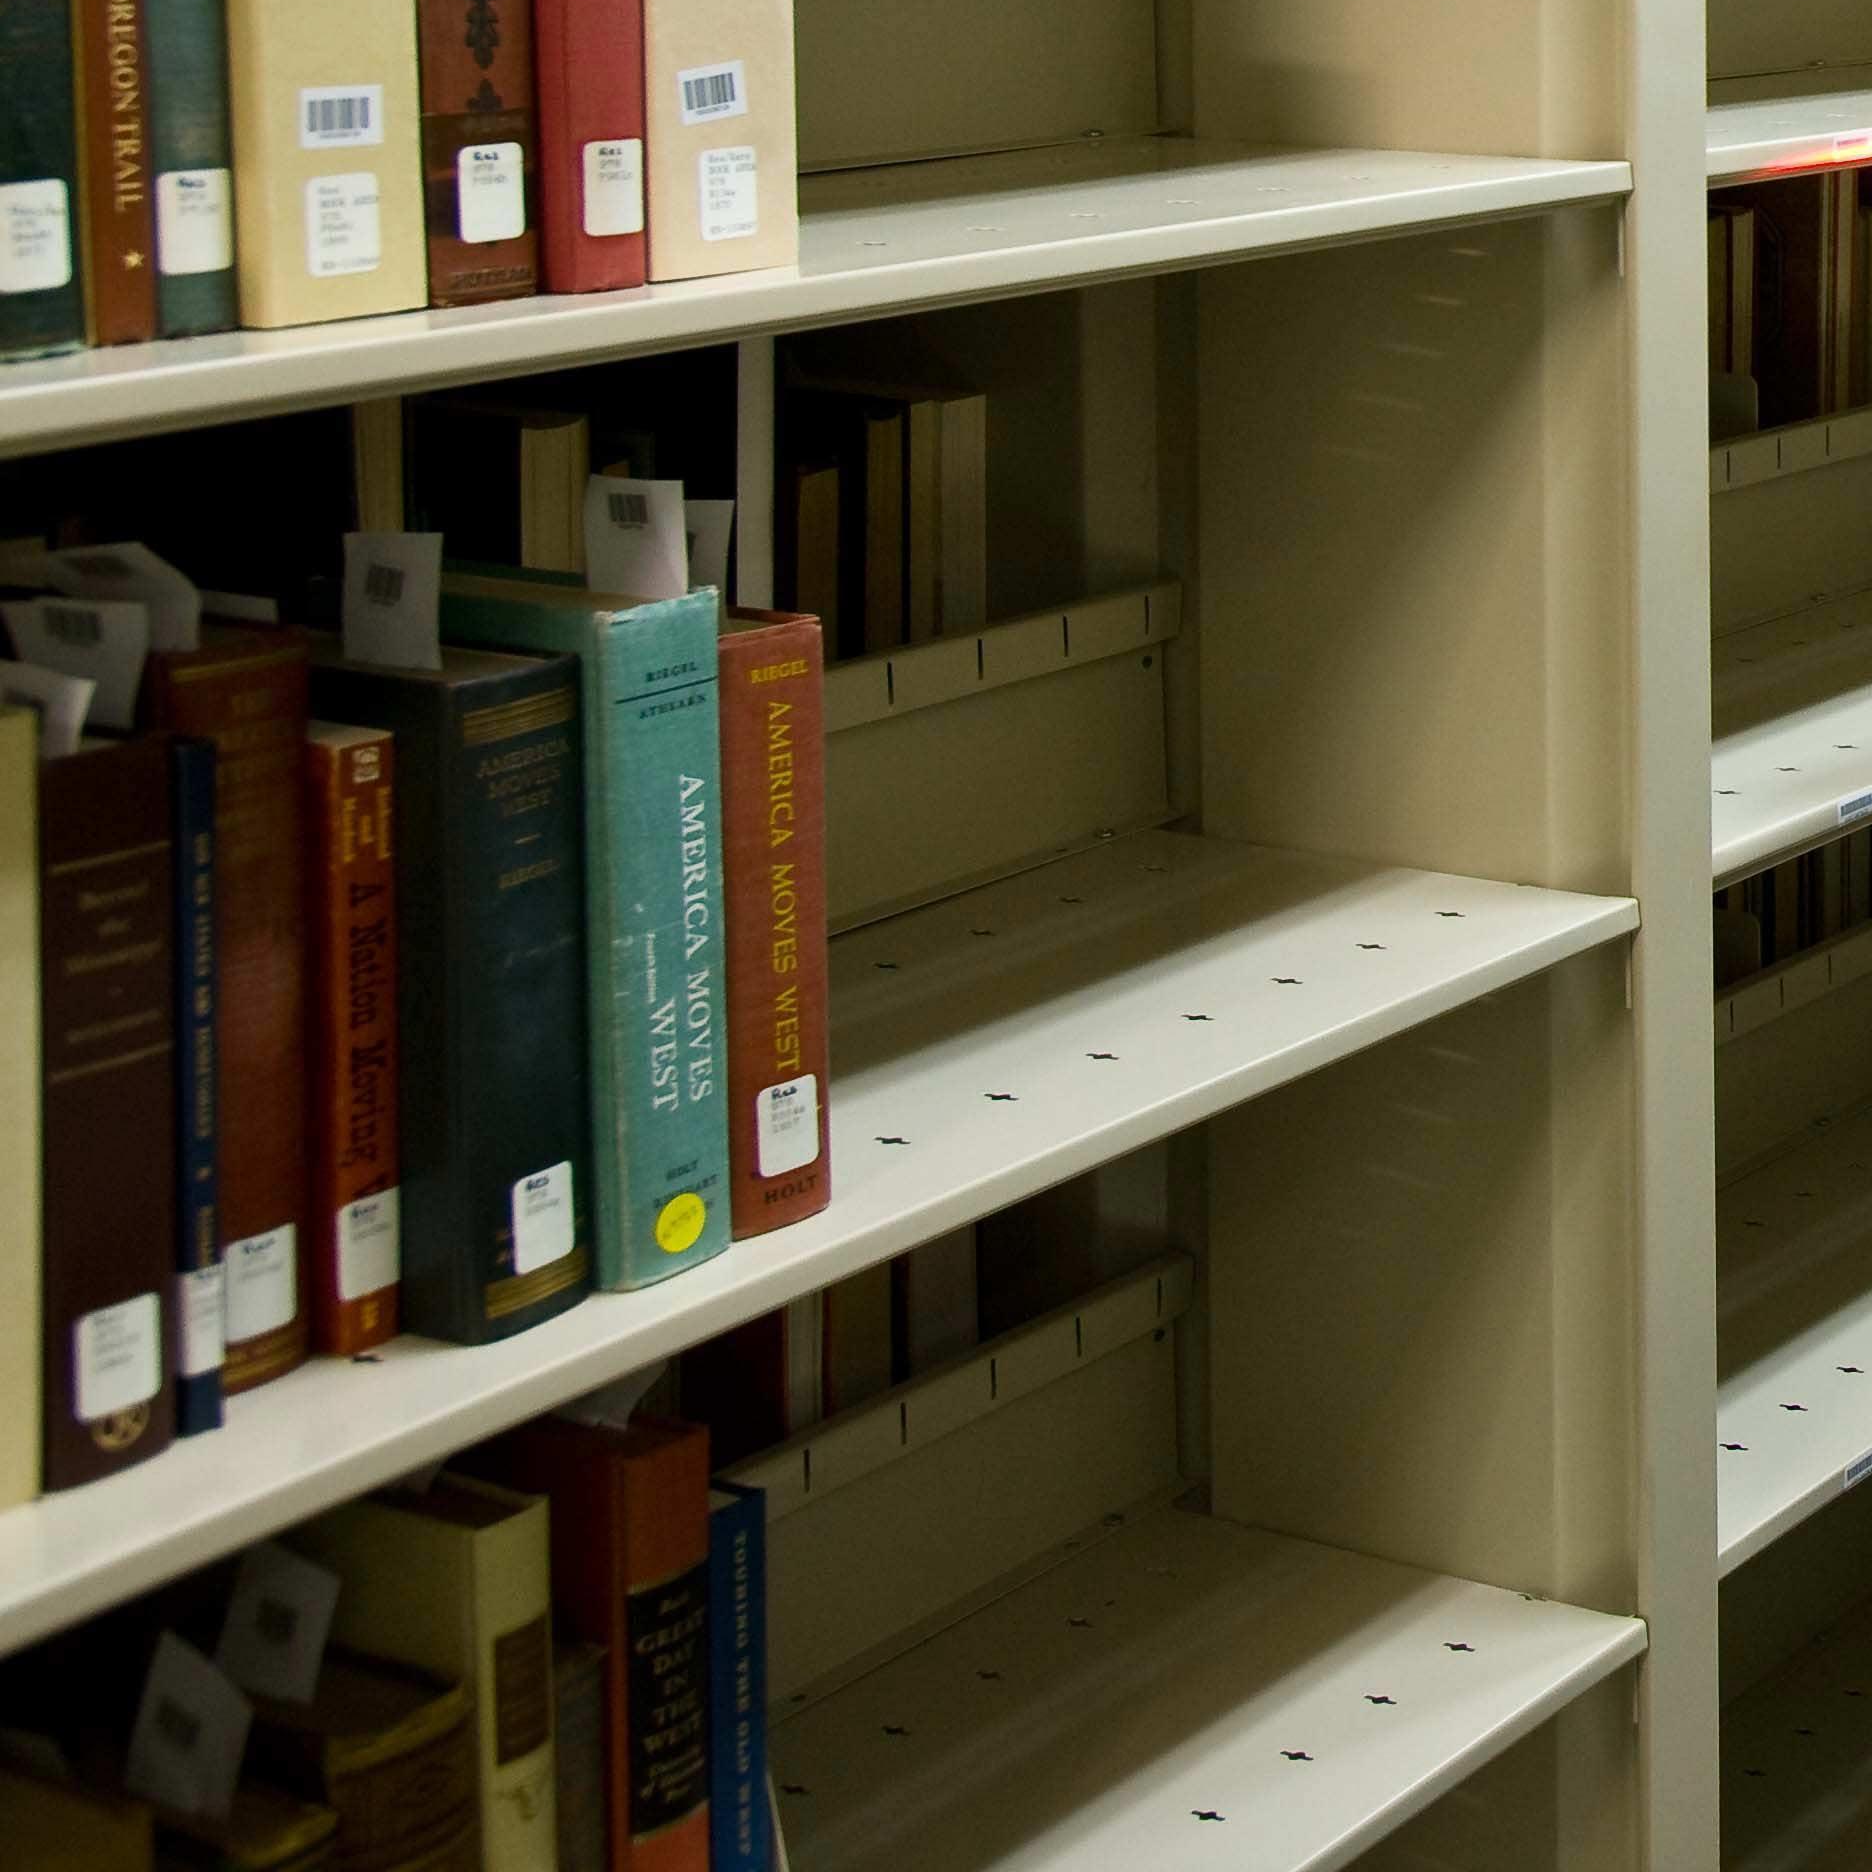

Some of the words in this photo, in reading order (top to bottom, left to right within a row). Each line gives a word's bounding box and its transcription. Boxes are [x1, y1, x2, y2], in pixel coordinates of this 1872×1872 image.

[112, 121, 144, 213] TRAIL
[644, 661, 699, 684] RIEGEL
[749, 659, 809, 685] RIEGEL
[475, 736, 571, 780] AMERICA
[767, 700, 796, 849] AMERICA
[349, 882, 384, 907] A
[679, 773, 710, 961] AMERICA
[770, 863, 798, 975] MOVES
[348, 919, 385, 1029] Nation
[650, 996, 680, 1113] WEST
[688, 969, 714, 1104] MOVES
[775, 985, 801, 1072] WEST
[764, 1175, 818, 1204] HOLT
[735, 1720, 753, 1775] OLD
